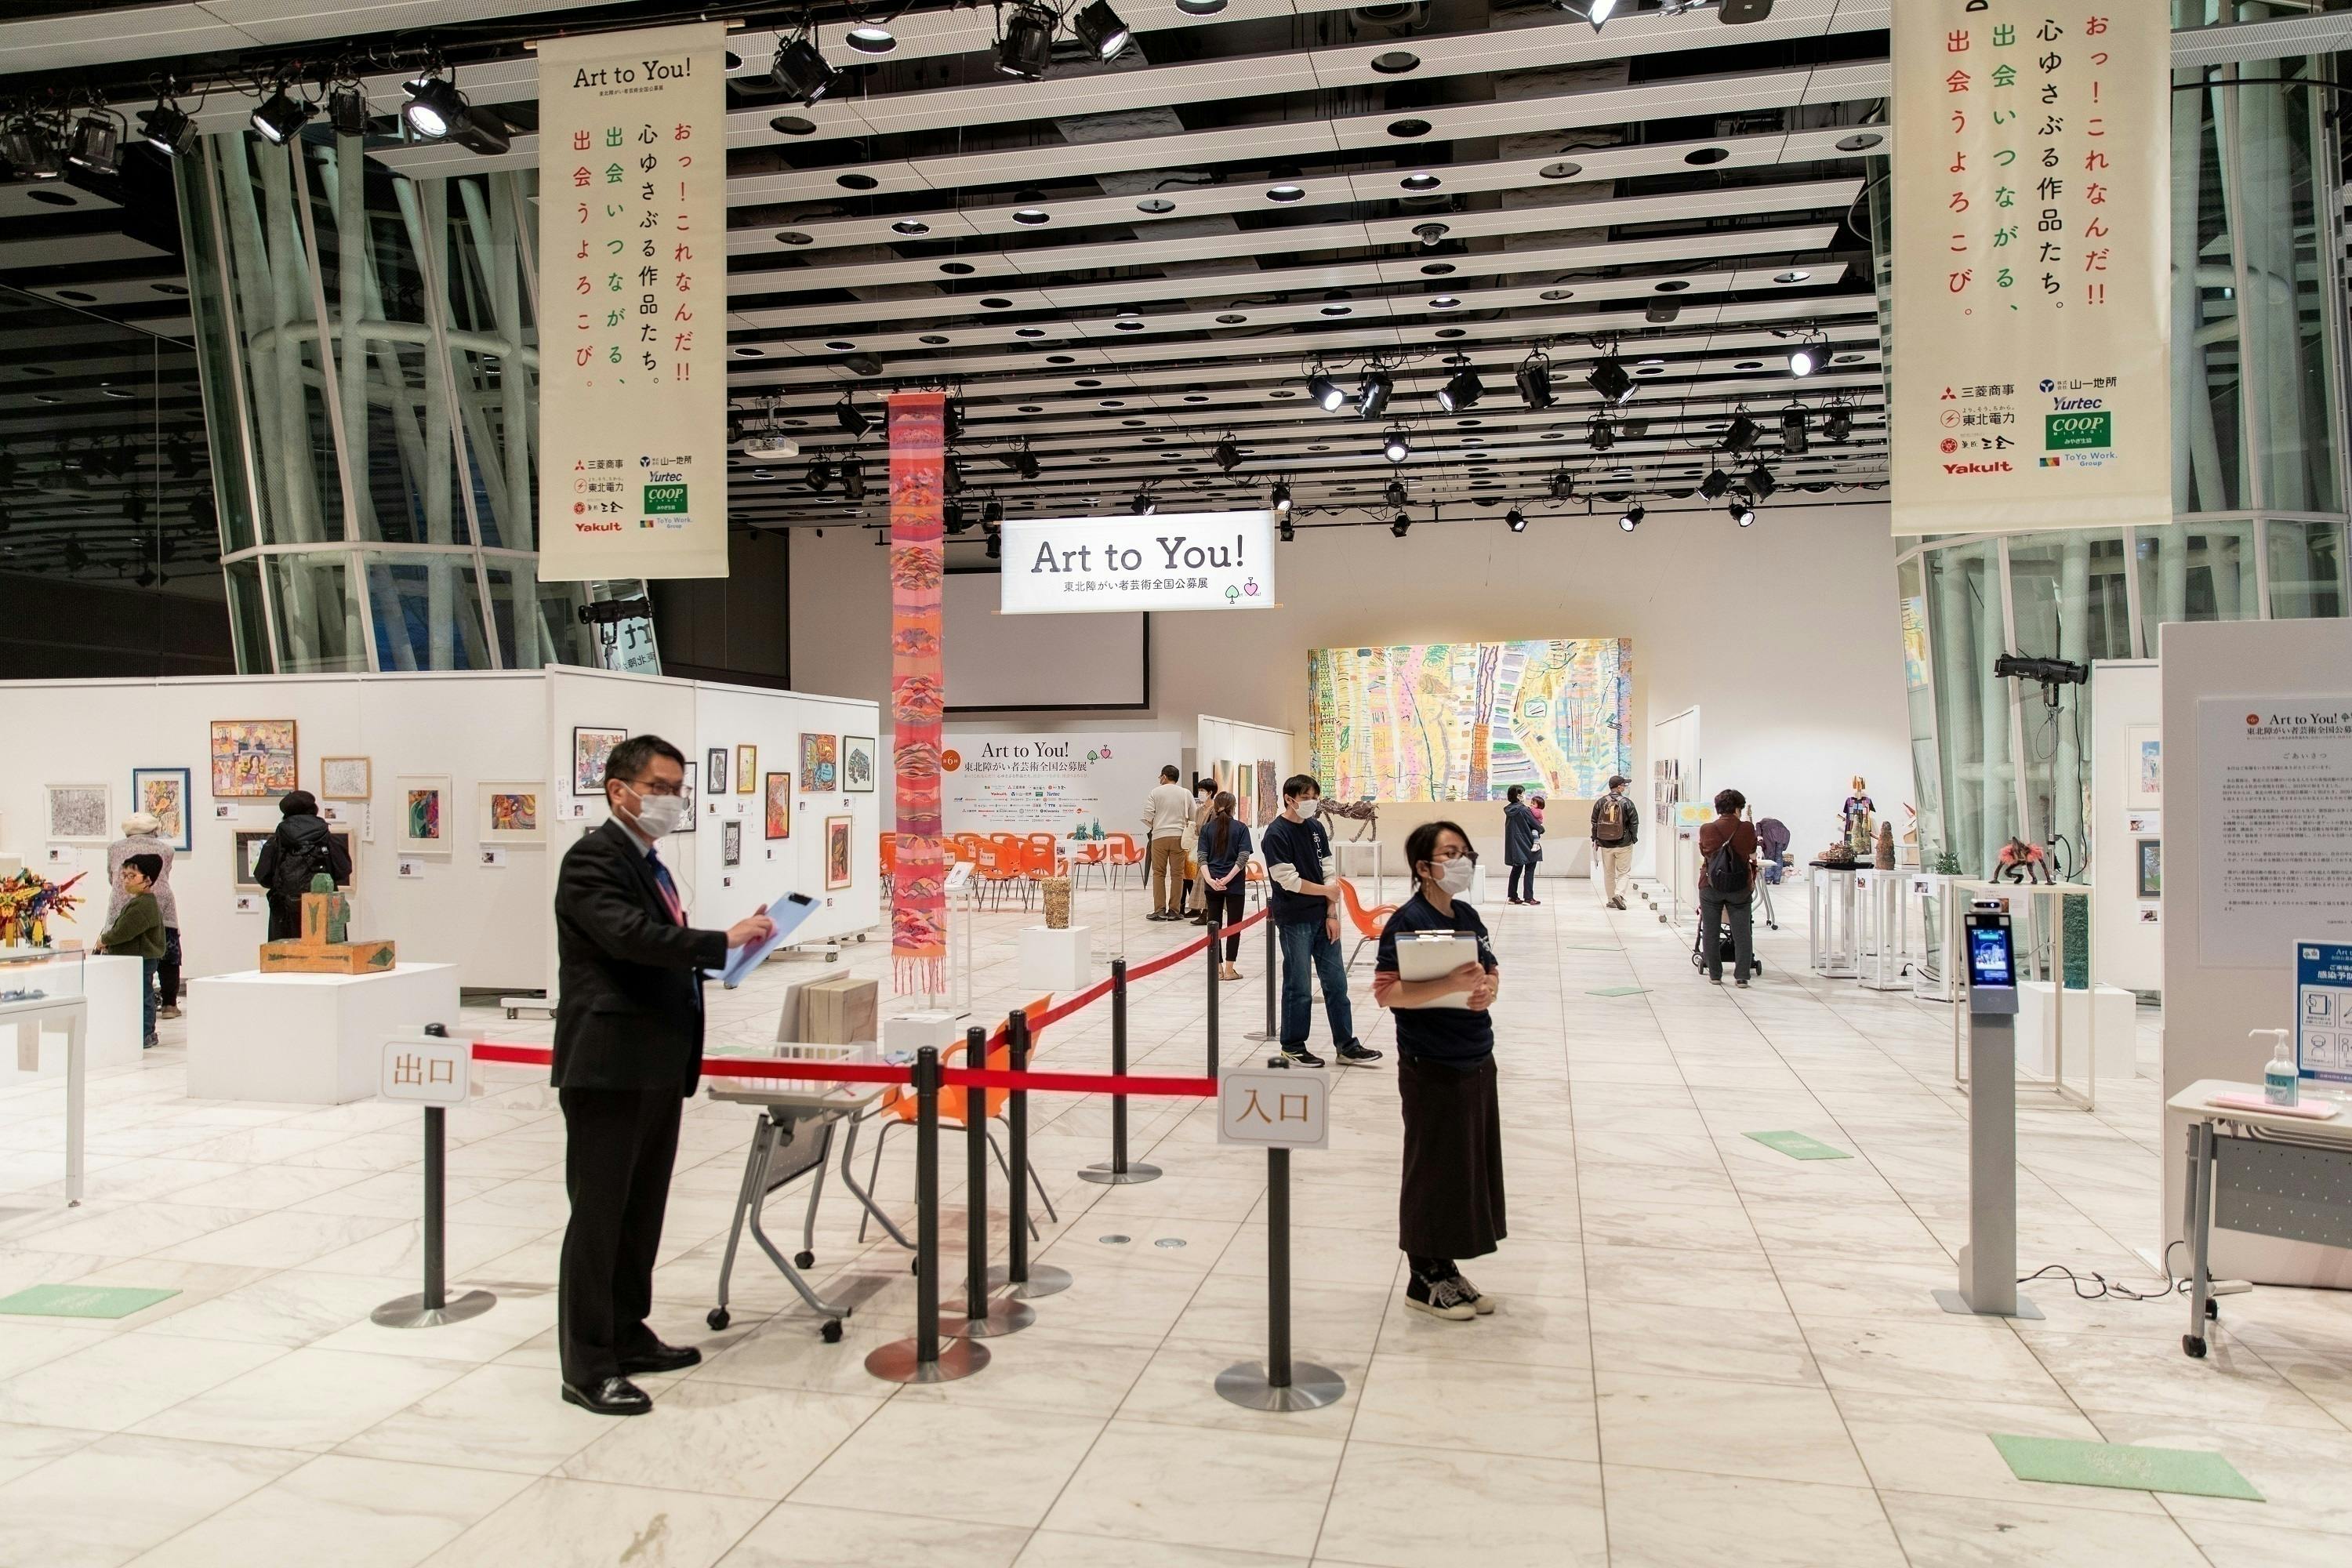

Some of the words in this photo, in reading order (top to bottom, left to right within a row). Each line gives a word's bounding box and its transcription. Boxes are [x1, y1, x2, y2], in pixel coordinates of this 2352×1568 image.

[573, 68, 607, 88] Art
[614, 67, 635, 84] to
[642, 57, 691, 80] You!
[1991, 23, 2018, 311] 出会いつながる、
[2036, 19, 2063, 309] 心ゆさぶる作品たち。
[1946, 29, 1973, 315] 出会うよろこび。
[572, 129, 593, 387] 出会うよろこび。
[605, 126, 626, 384] 出会いつながる、
[638, 124, 659, 384] 心ゆさぶる作品たち。
[2071, 376, 2117, 389] 山一地所
[1962, 384, 2015, 397] 三菱商事
[2054, 396, 2103, 410] Yurtec
[1962, 412, 2015, 426] 東北電力
[2053, 417, 2103, 431] COOP
[588, 459, 623, 470] 三菱商事
[660, 456, 691, 466] 山一地所
[1943, 461, 2013, 474] Yakult
[650, 470, 682, 482] Yurtec
[589, 482, 624, 492] 東北電力
[648, 488, 684, 499] COOP
[575, 522, 622, 532] Yakult
[1031, 541, 1091, 572] Art
[1105, 544, 1142, 571] to
[1156, 534, 1244, 568] You!
[1064, 577, 1208, 592] 東北障がい者芸術全国公募展
[2270, 714, 2290, 724] Art
[2295, 715, 2307, 724] to
[2310, 713, 2337, 724] You!
[982, 742, 1009, 757] Art
[1014, 746, 1029, 757] to
[1034, 742, 1069, 757] You!
[964, 761, 1087, 772] 東北障がい者芸術全国公募展
[395, 1054, 453, 1086] 出口
[1236, 1089, 1308, 1123] 入口
